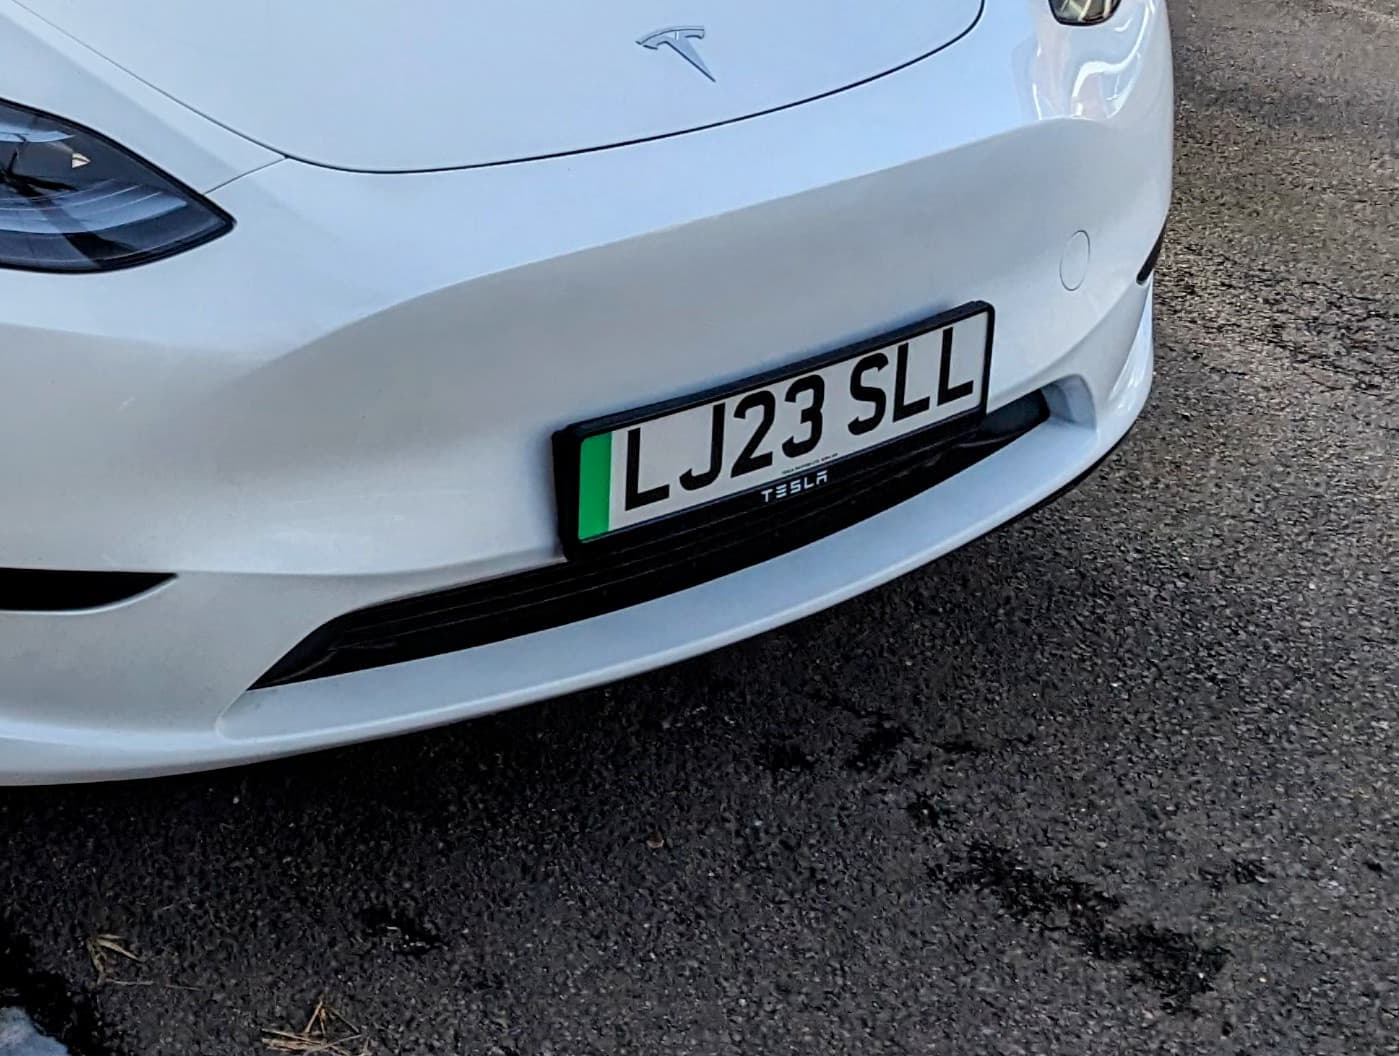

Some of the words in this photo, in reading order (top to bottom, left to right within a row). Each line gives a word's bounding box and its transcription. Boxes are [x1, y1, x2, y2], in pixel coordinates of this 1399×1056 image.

[625, 373, 825, 511] LJ23
[847, 327, 974, 436] SLL
[761, 470, 828, 503] TESLA
